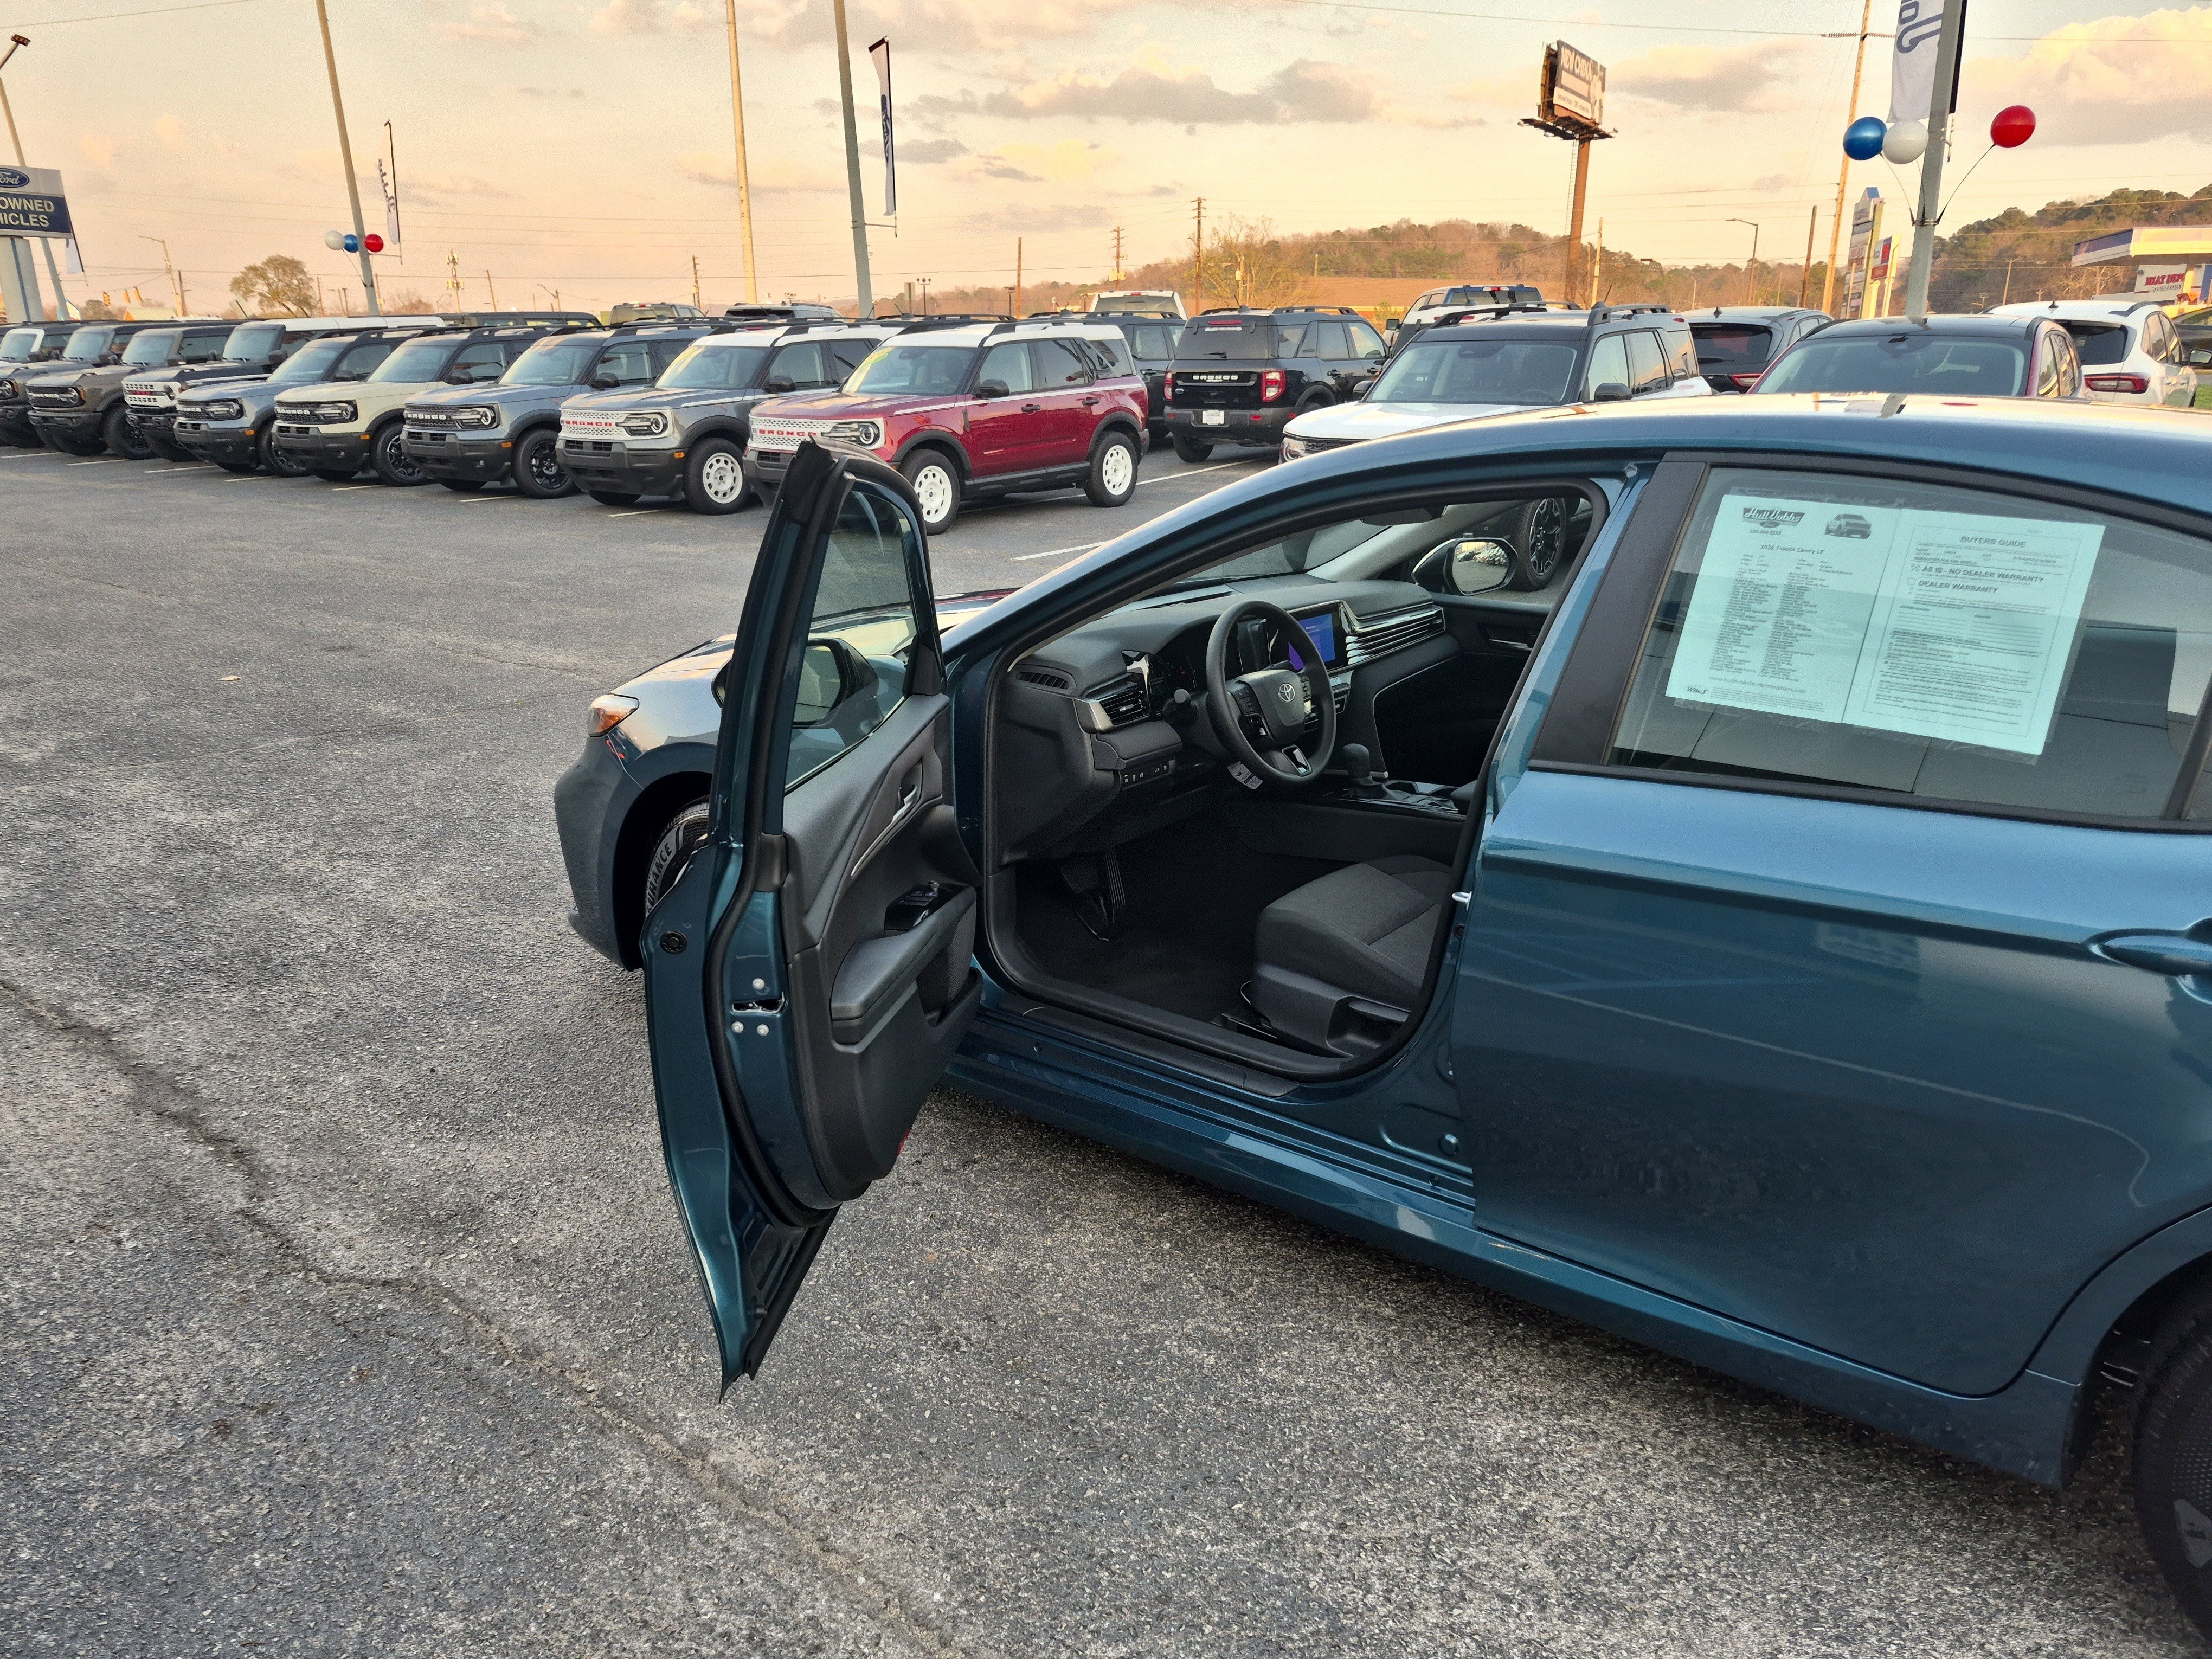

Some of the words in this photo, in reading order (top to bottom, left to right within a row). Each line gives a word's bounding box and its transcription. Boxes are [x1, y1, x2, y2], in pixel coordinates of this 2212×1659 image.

[1960, 536, 1996, 545] BUYERS
[1998, 539, 2027, 548] GUIDE
[1962, 569, 1995, 578] DEALER
[1997, 572, 2044, 583] WARRANTY
[1918, 580, 1950, 589] DEALER
[1951, 583, 1998, 594] WARRANTY
